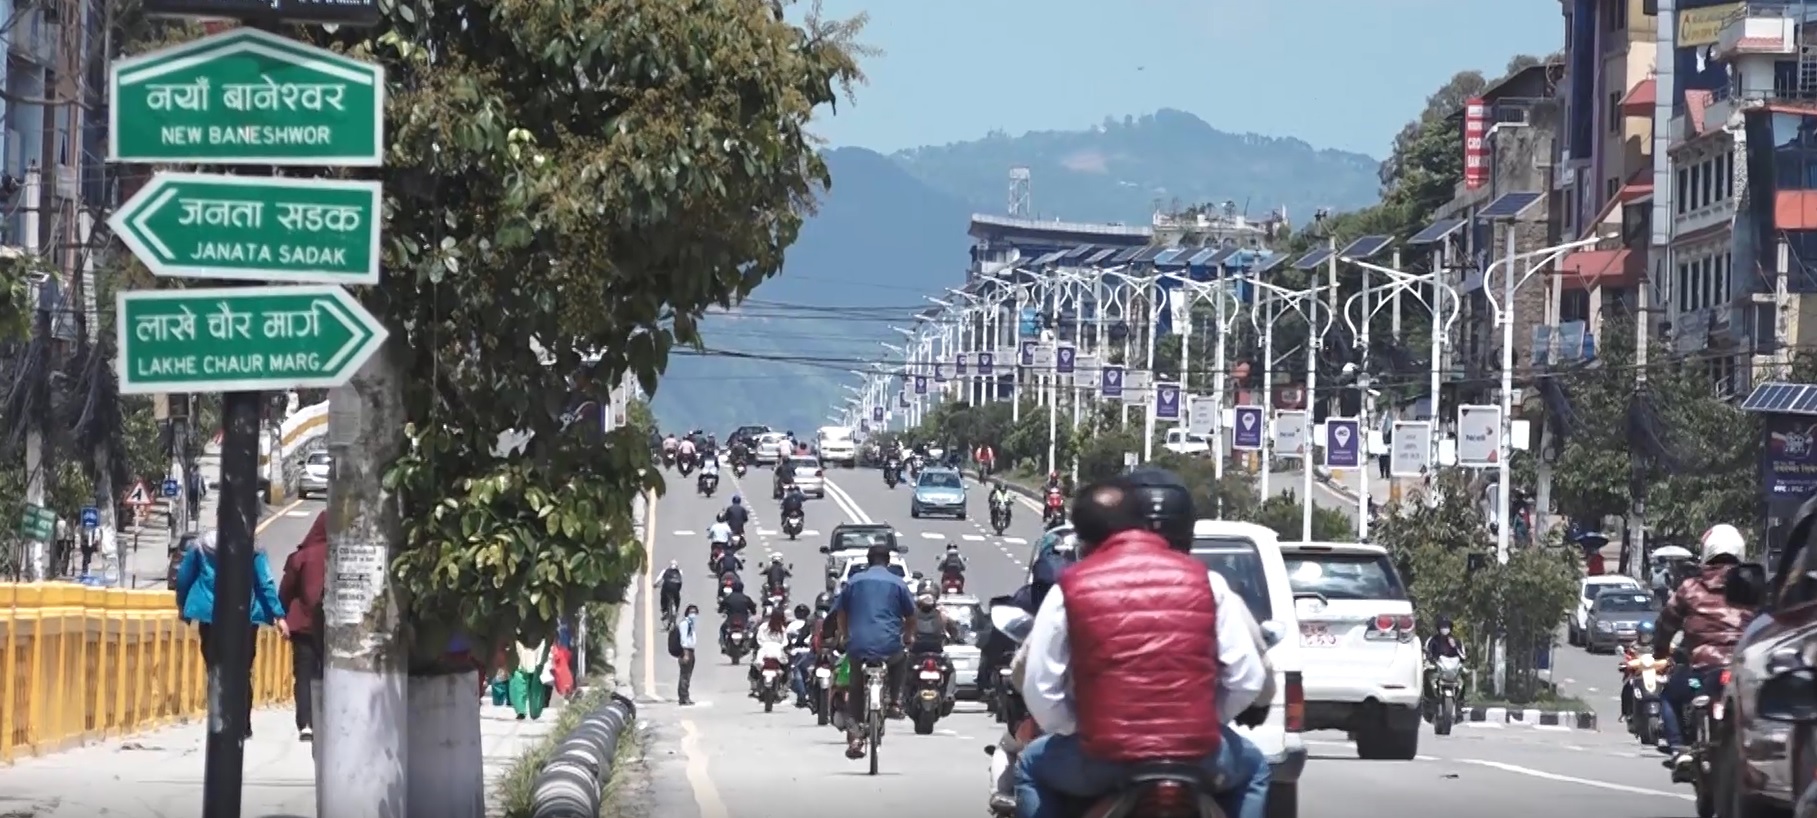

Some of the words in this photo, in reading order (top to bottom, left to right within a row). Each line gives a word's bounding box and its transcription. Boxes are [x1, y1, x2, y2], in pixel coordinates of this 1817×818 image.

[145, 74, 210, 111] नयाँ
[221, 74, 347, 111] बानेश्वर
[160, 125, 201, 145] NEW
[208, 125, 332, 146] BANESHWOR
[178, 197, 264, 229] जनता
[275, 201, 363, 232] सडक
[190, 242, 272, 263] JANATA
[278, 244, 346, 266] SADAK
[135, 304, 197, 341] लाखे
[206, 302, 253, 340] चौर
[137, 356, 198, 376] LAKHE
[203, 354, 264, 374] CHAUR
[269, 352, 321, 372] MARG
